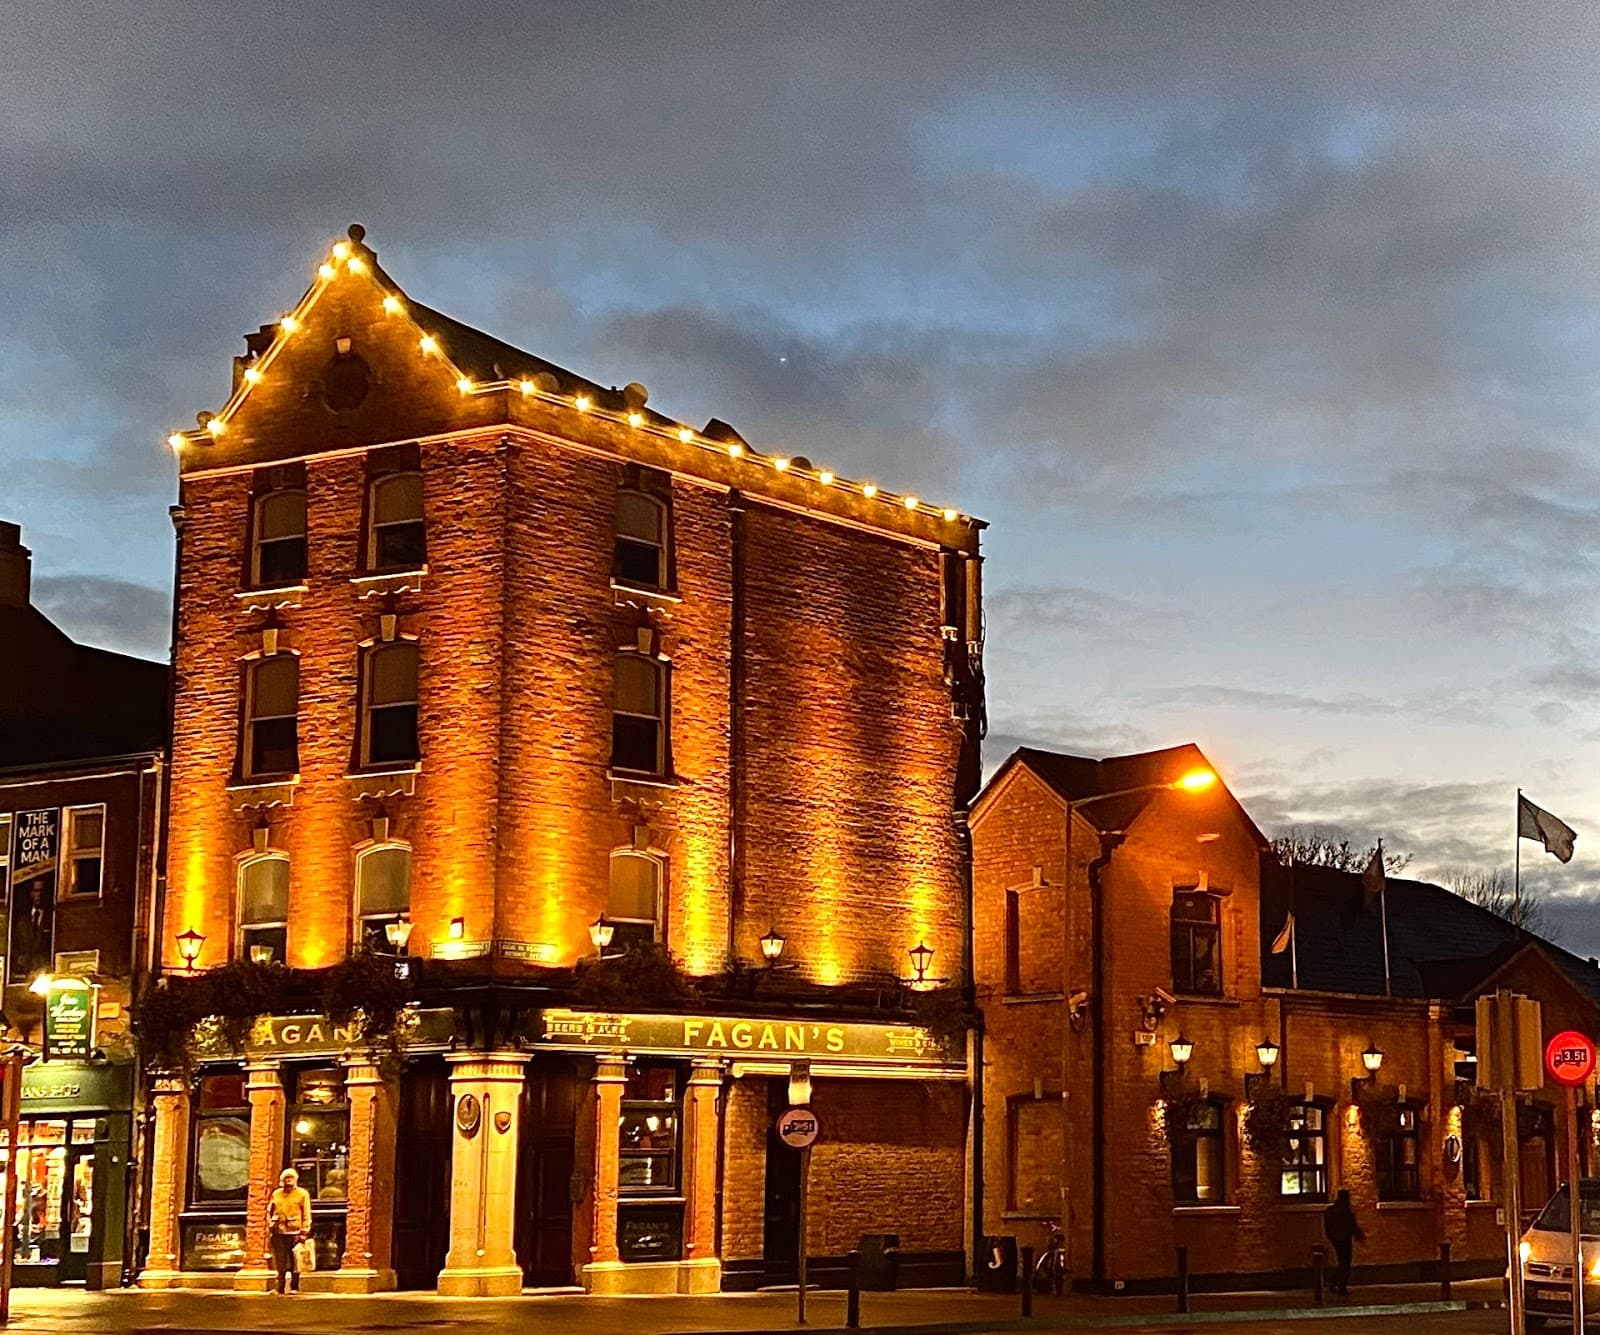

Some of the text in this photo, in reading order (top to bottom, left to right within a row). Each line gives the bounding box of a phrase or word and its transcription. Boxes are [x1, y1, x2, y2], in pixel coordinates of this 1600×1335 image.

[25, 811, 49, 825] THE
[18, 823, 55, 839] MARK
[22, 837, 49, 851] OF A
[20, 849, 49, 864] MAN
[546, 1023, 583, 1033] BEERS
[683, 1020, 844, 1052] FAGAN'S
[1564, 1050, 1586, 1061] 3.5t
[195, 1232, 239, 1242] FAGAN'S
